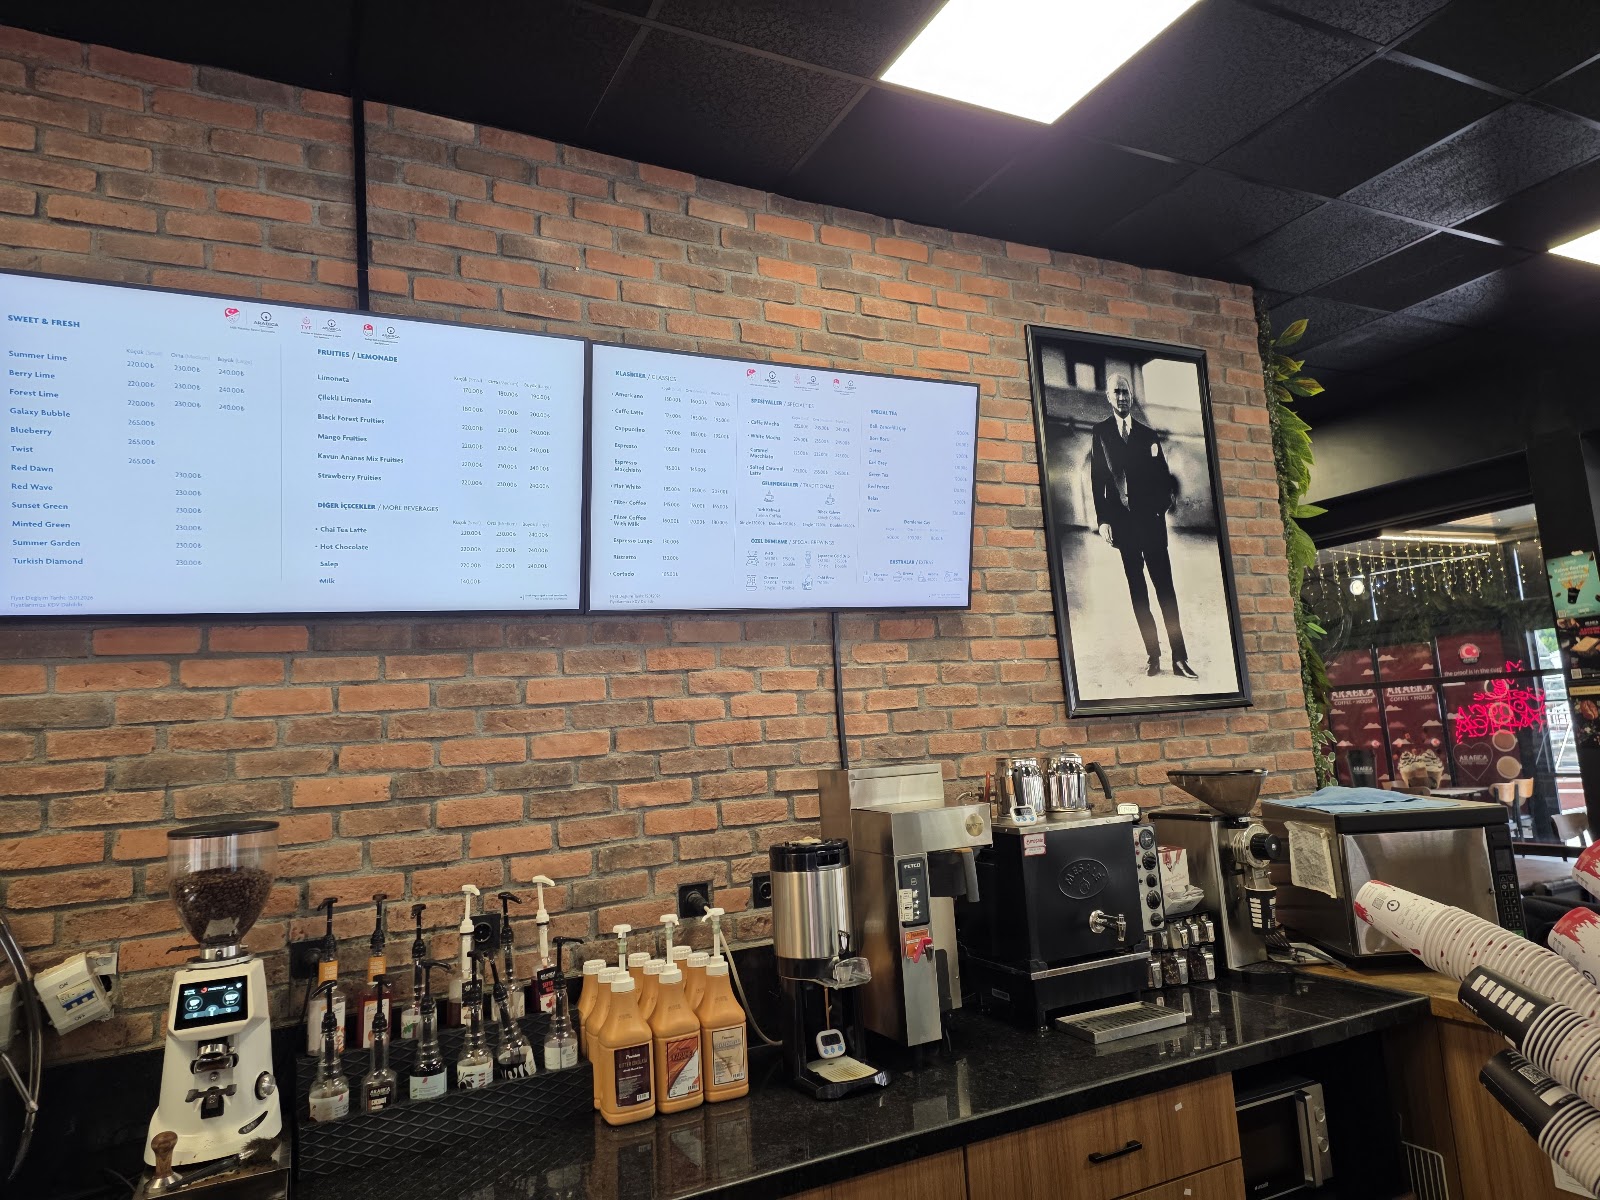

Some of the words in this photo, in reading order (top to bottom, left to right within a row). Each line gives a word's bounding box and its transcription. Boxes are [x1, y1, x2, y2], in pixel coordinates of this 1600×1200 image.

[8, 315, 39, 323] SWEET
[52, 319, 80, 327] FRESH
[9, 350, 44, 359] Summer
[318, 349, 349, 357] FRUITIES
[357, 353, 397, 362] LEMONADE
[9, 370, 32, 378] Berry
[10, 408, 38, 417] Galaxy
[11, 426, 52, 436] Blueberry
[318, 473, 355, 481] Strawberry
[1331, 689, 1376, 699] ARABICA
[1386, 685, 1435, 697] ARABICA
[59, 981, 68, 990] ON
